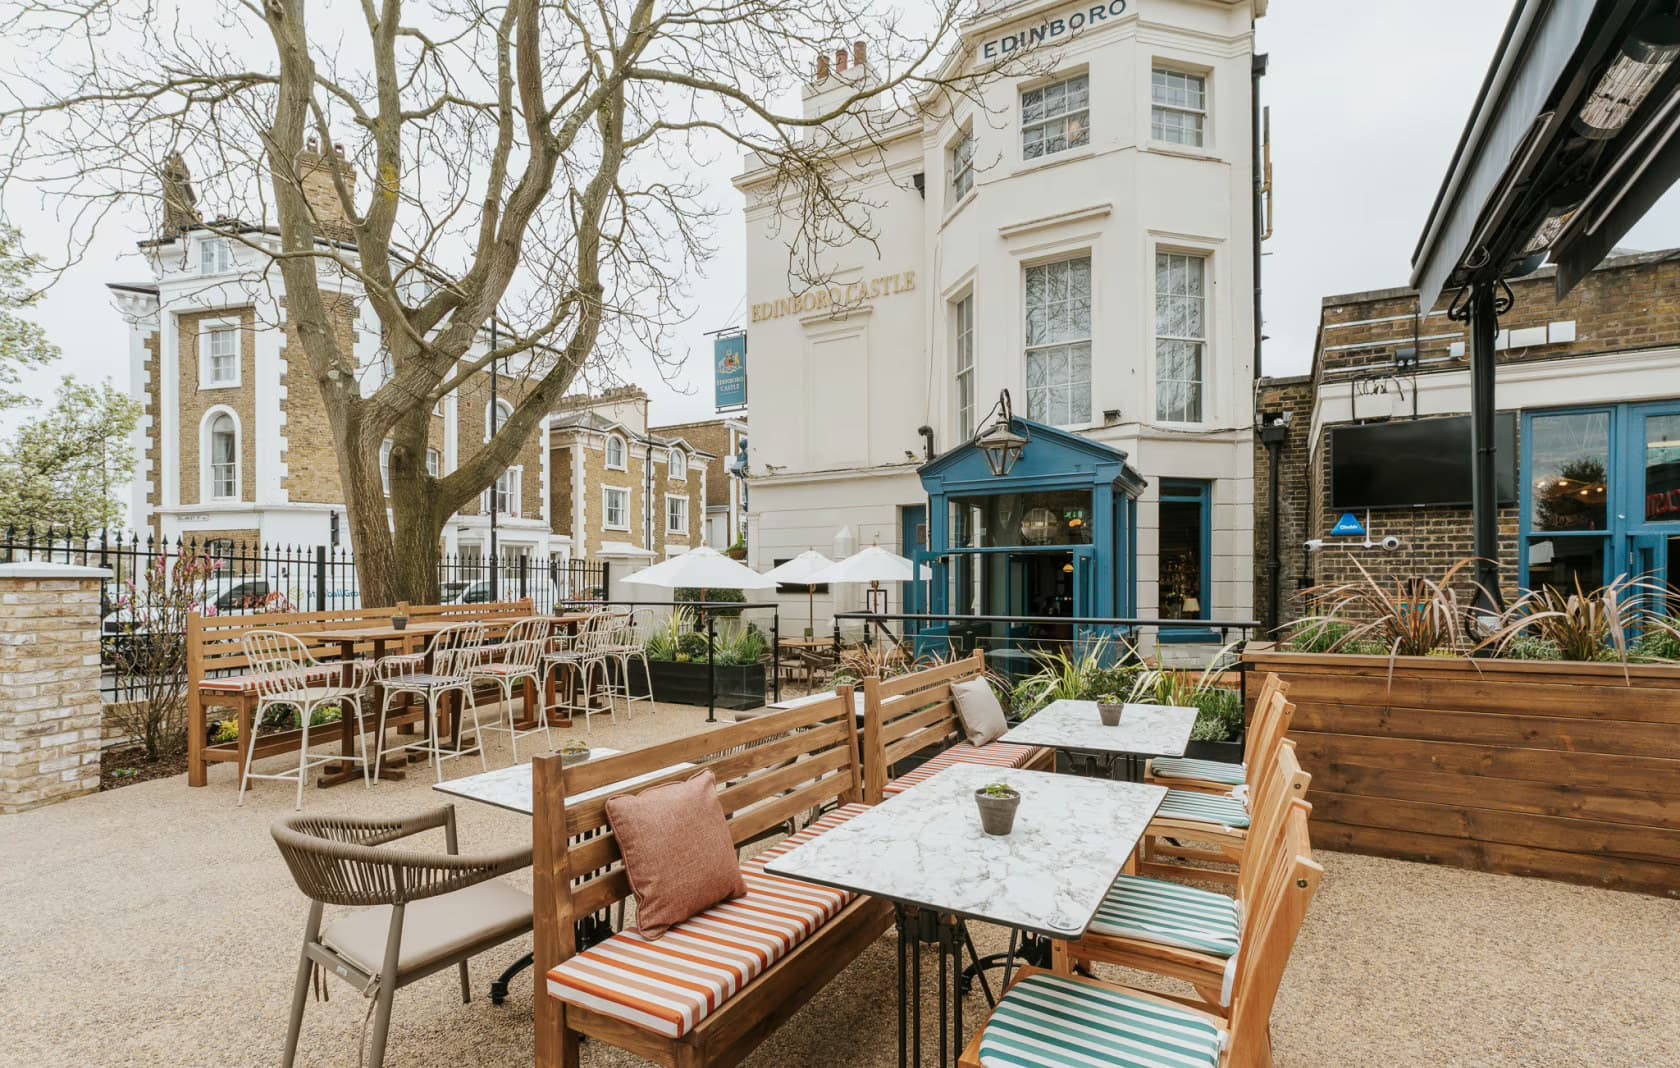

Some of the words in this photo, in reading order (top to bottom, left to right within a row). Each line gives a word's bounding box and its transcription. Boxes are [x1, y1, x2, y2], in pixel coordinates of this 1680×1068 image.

[983, 0, 1127, 59] EDINBORO
[752, 287, 841, 323] EDINBORO
[846, 271, 916, 304] CASTLE
